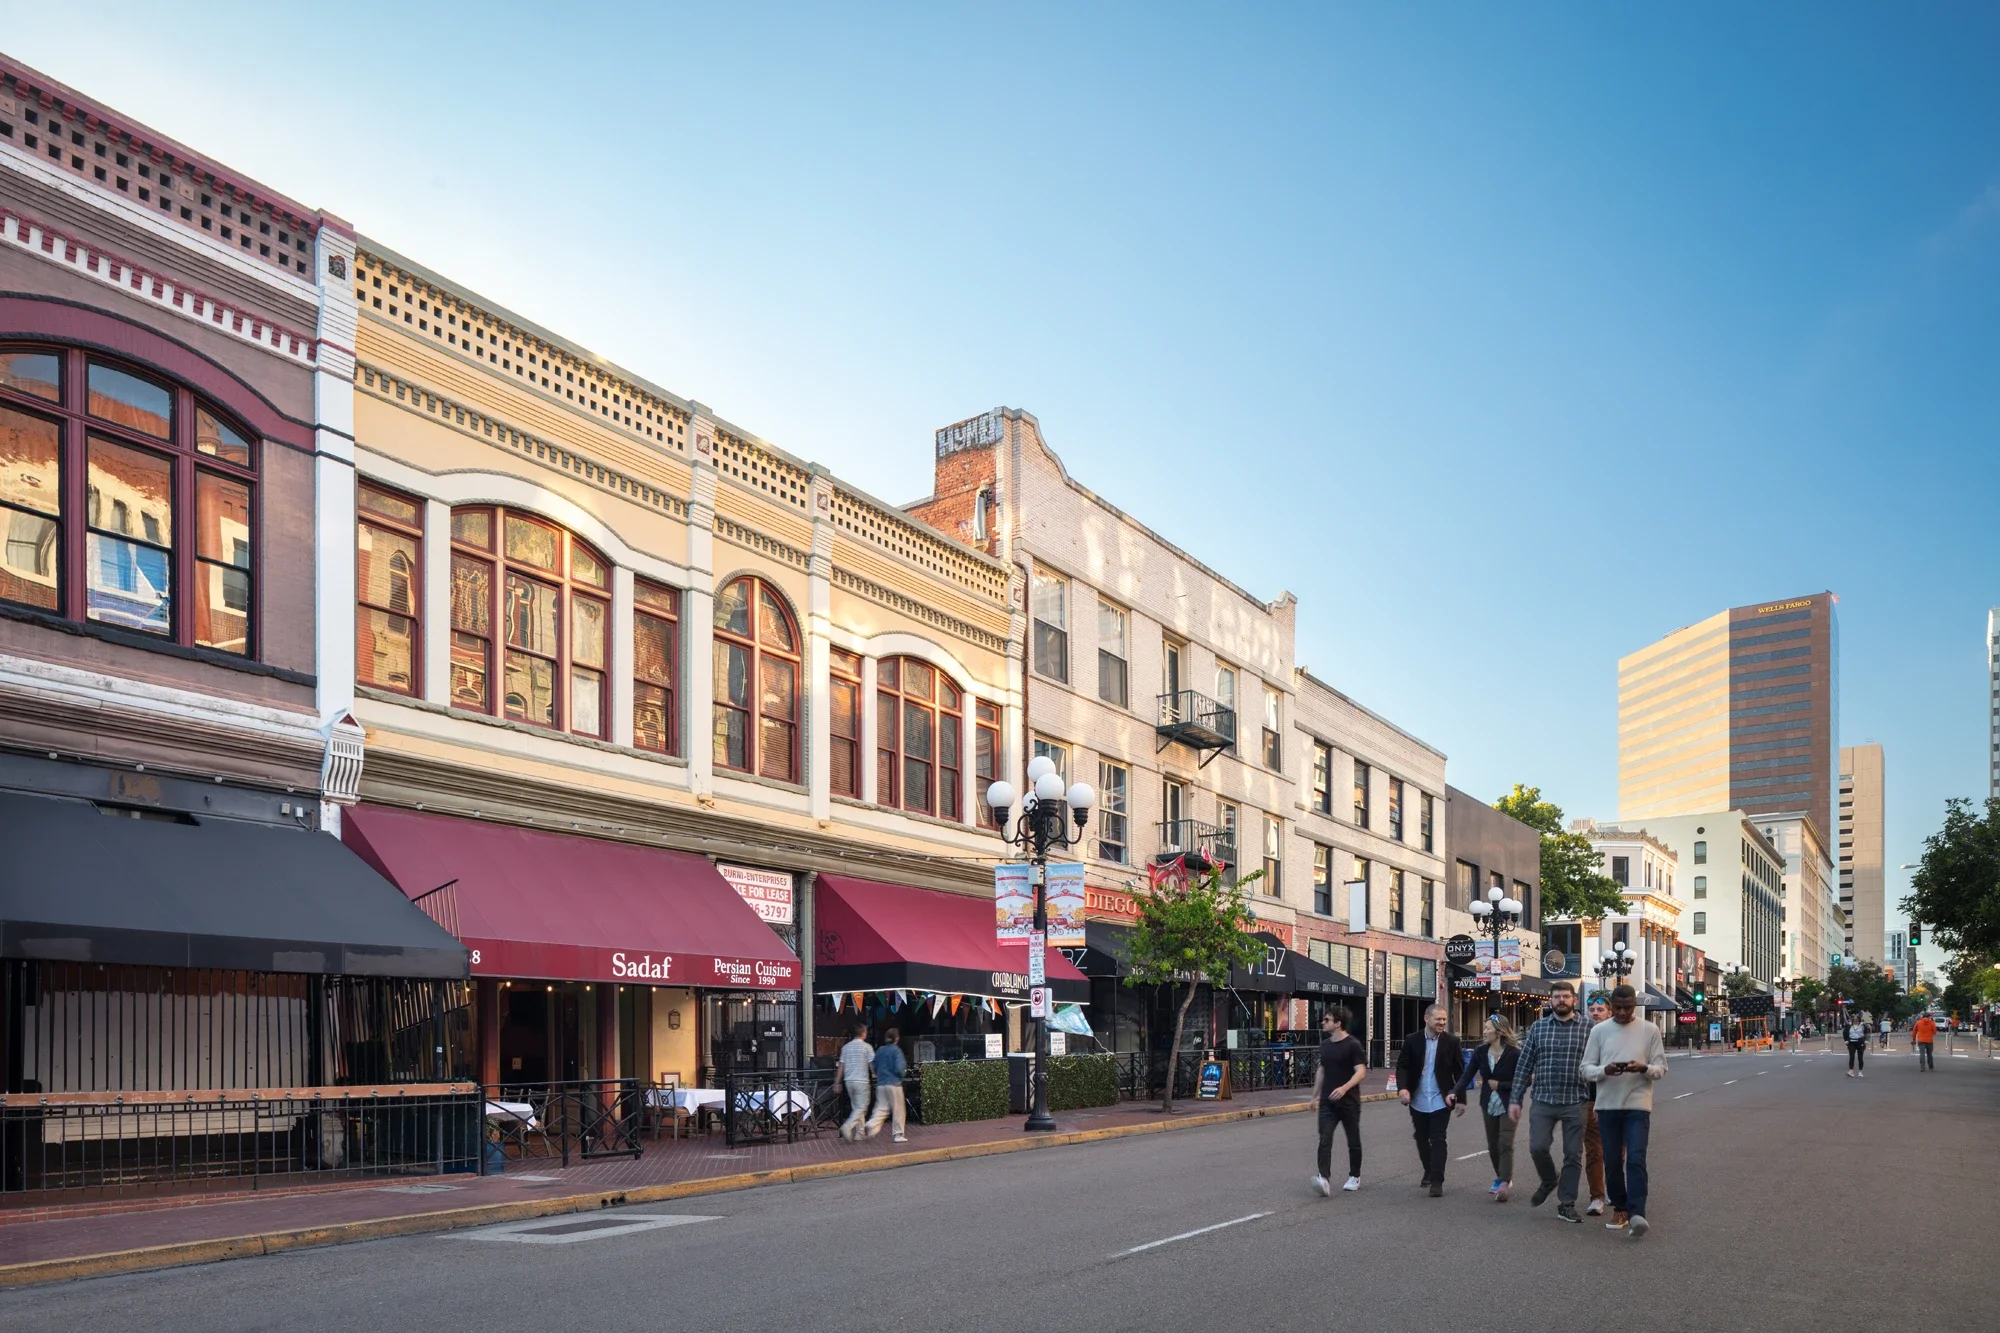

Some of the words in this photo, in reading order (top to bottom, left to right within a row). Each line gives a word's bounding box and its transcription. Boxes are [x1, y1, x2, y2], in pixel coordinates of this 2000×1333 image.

[1758, 604, 1784, 613] WELLS
[1786, 600, 1812, 609] FARGO
[731, 884, 747, 896] ACE
[749, 887, 765, 899] FOR
[766, 889, 789, 902] LEASE
[1085, 891, 1137, 915] DIEGO
[1447, 944, 1474, 952] ONYX
[612, 953, 673, 979] Sadaf
[714, 958, 751, 975] Persian
[755, 961, 792, 977] Cuisine
[730, 975, 750, 984] Since
[758, 976, 776, 986] 1990
[992, 972, 1029, 990] CASABLANCA
